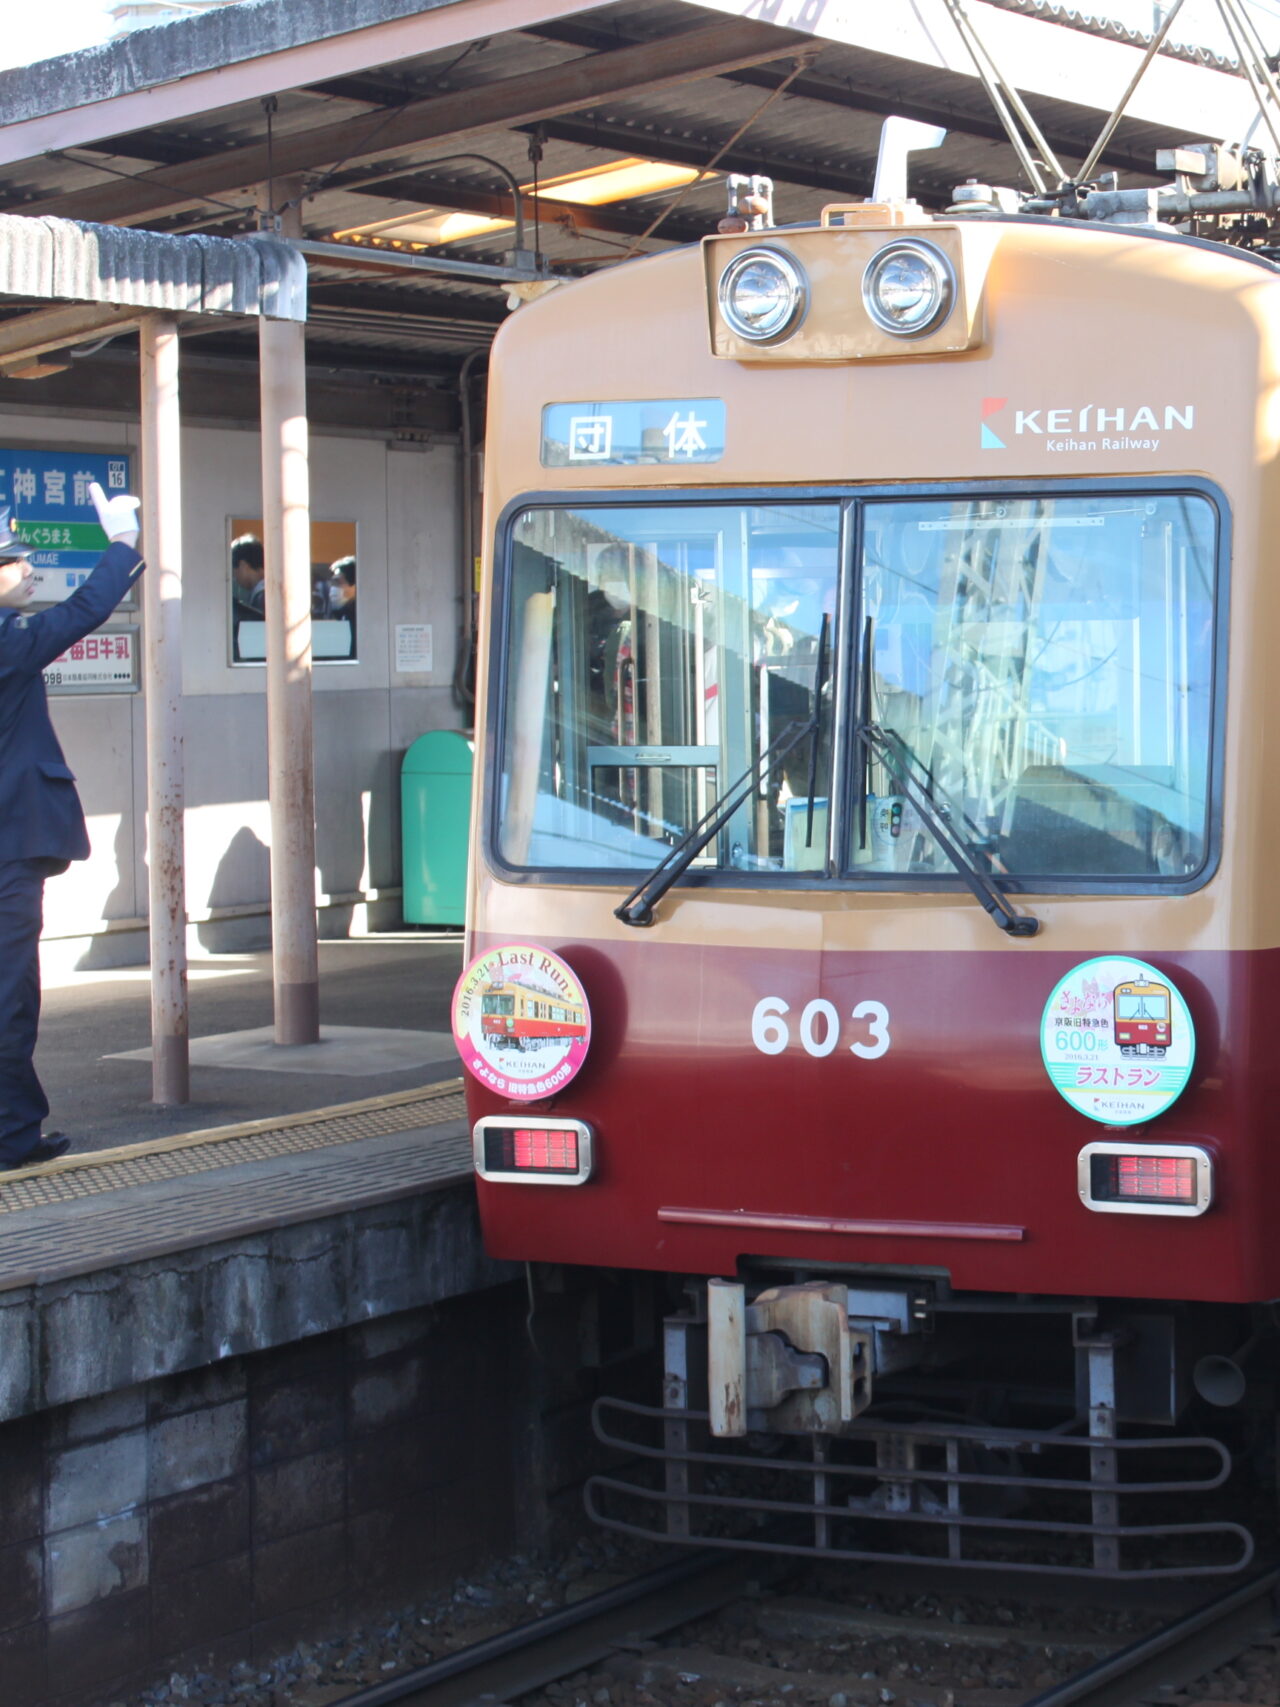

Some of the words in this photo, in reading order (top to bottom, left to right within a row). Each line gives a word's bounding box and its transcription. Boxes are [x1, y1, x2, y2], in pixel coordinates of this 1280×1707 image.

[1015, 404, 1194, 434] KEIHAN
[1047, 439, 1096, 452] Keihan
[1102, 437, 1160, 452] Railway
[0, 467, 95, 506] 神宮前
[111, 472, 123, 486] 16
[497, 950, 535, 968] Last
[540, 955, 570, 992] Run
[750, 996, 891, 1059] 603
[1055, 1017, 1109, 1028] 京阪旧特急色
[1076, 1067, 1161, 1087] ラストラン
